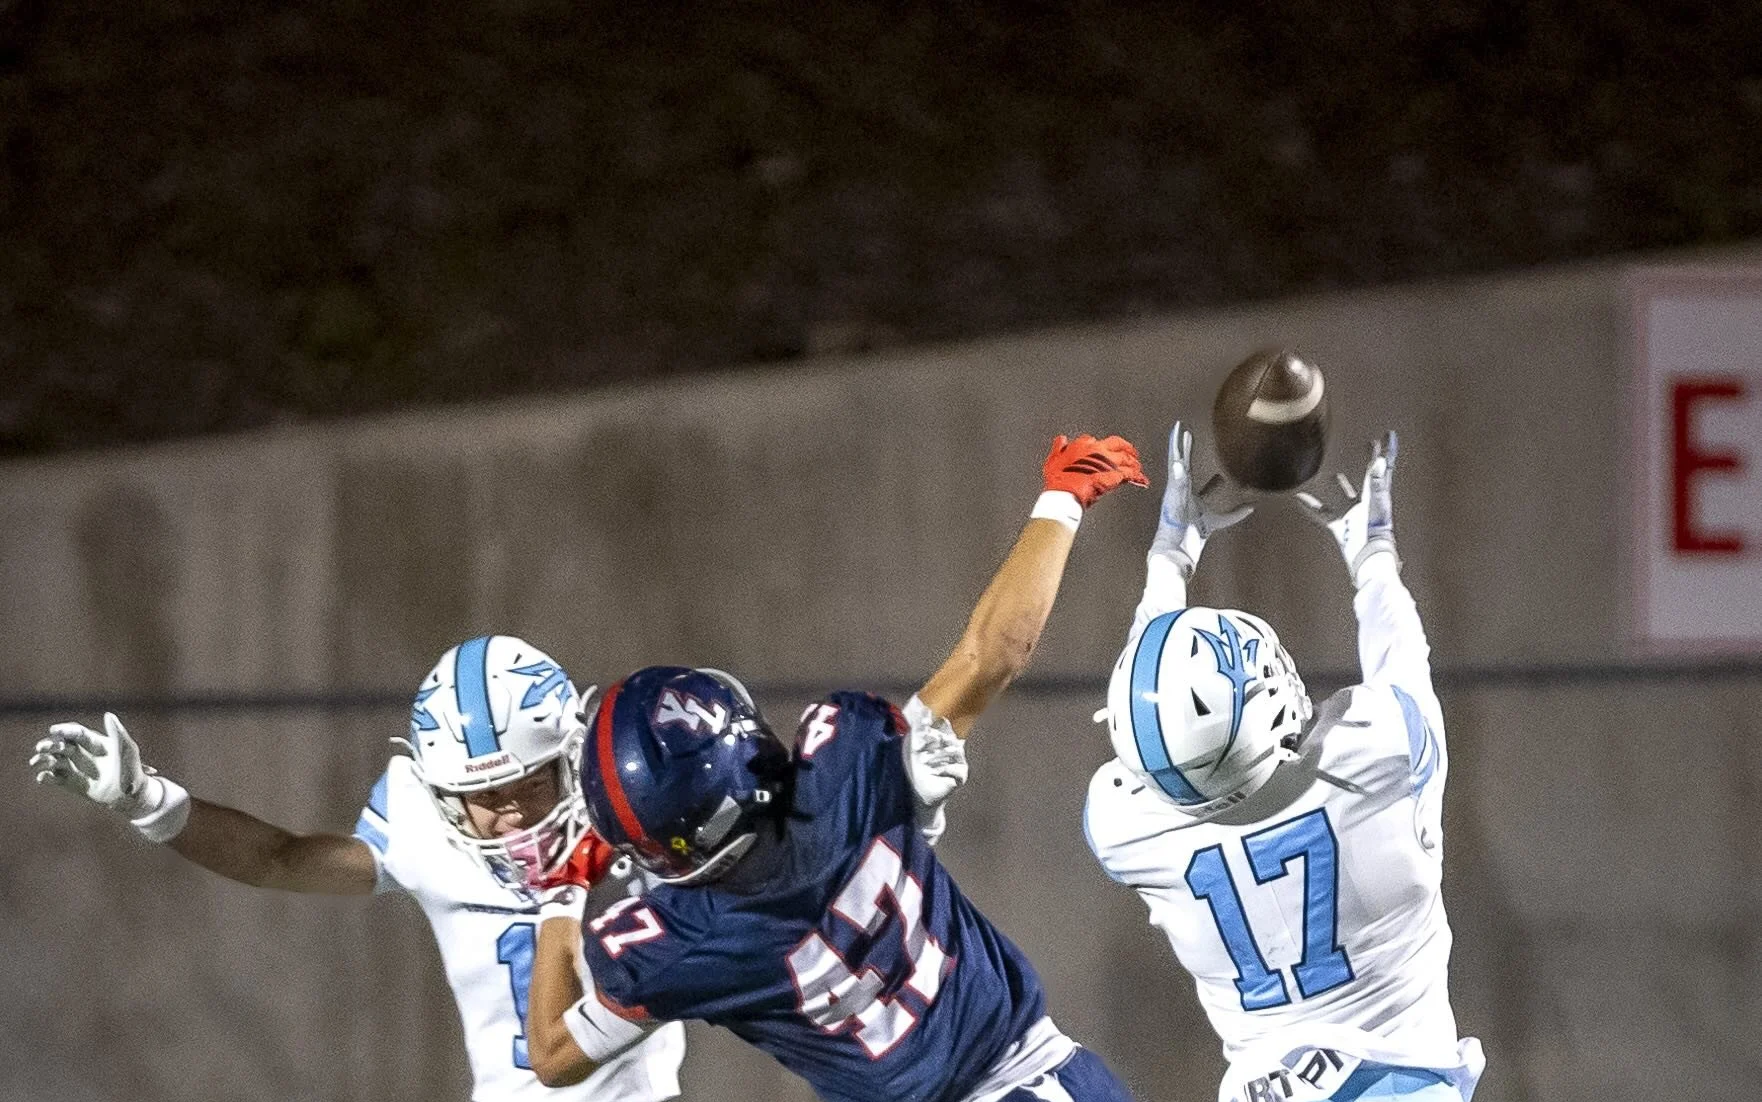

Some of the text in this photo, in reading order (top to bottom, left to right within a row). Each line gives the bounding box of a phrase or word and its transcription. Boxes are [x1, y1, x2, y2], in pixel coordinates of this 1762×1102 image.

[465, 754, 510, 773] Riddell
[786, 835, 956, 1061] 47
[1184, 807, 1355, 1012] 17
